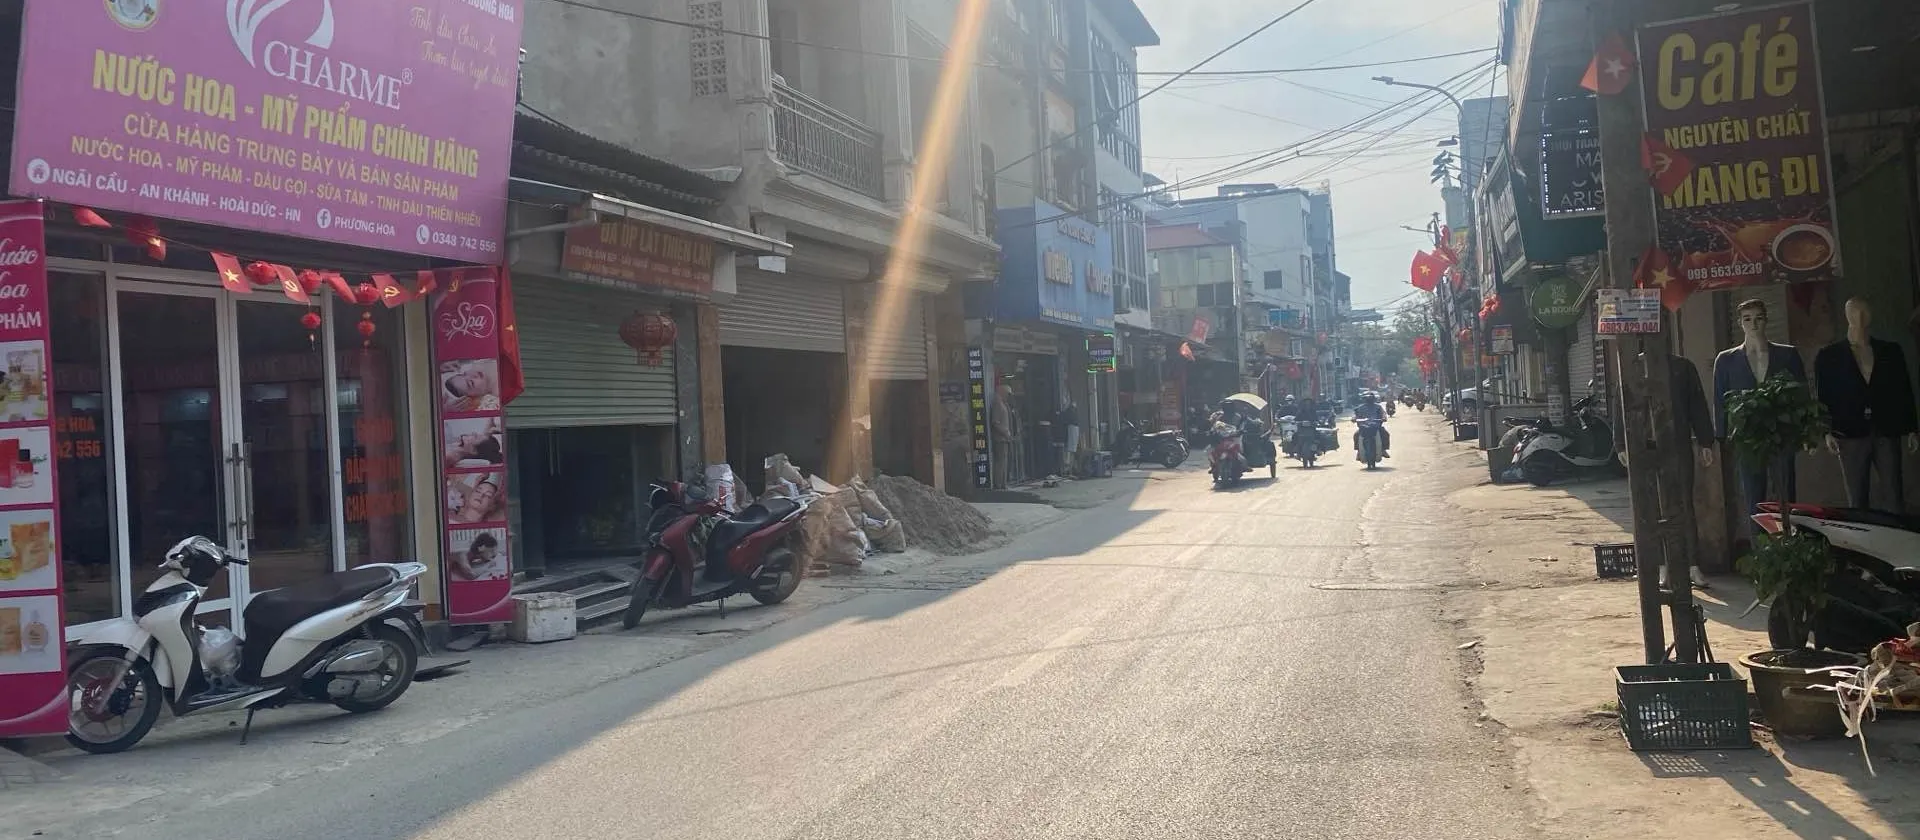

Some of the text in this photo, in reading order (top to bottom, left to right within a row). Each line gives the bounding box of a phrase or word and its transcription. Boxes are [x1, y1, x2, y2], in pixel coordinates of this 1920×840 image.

[498, 3, 514, 23] HOA
[1657, 16, 1799, 111] Café
[92, 48, 176, 106] NƯỚC
[184, 73, 237, 122] HOA
[261, 93, 299, 136] MỸ
[303, 101, 367, 152] PHẨM
[371, 122, 430, 168] CHÍNH
[432, 136, 479, 179] HÃNG
[1663, 103, 1811, 150] NGUYÊN CHẤT
[71, 134, 124, 162] NƯỚC
[128, 147, 163, 170] HOA
[176, 155, 200, 175] MỸ
[284, 175, 307, 197] GỌI
[124, 112, 170, 142] CỬA
[176, 122, 231, 154] HÀNG
[236, 136, 297, 168] TRƯNG
[301, 150, 334, 177] BÀY
[337, 157, 357, 181] VÀ
[95, 171, 129, 193] CẦU
[139, 183, 160, 199] AN
[163, 184, 209, 208] KHÁNH
[219, 195, 249, 214] HOÀI
[252, 199, 276, 218] ĐỨC
[285, 207, 301, 223] HN
[1780, 154, 1820, 197] ĐI
[334, 215, 396, 237] PHƯƠNG HOA
[432, 231, 497, 253] 0348 742 556
